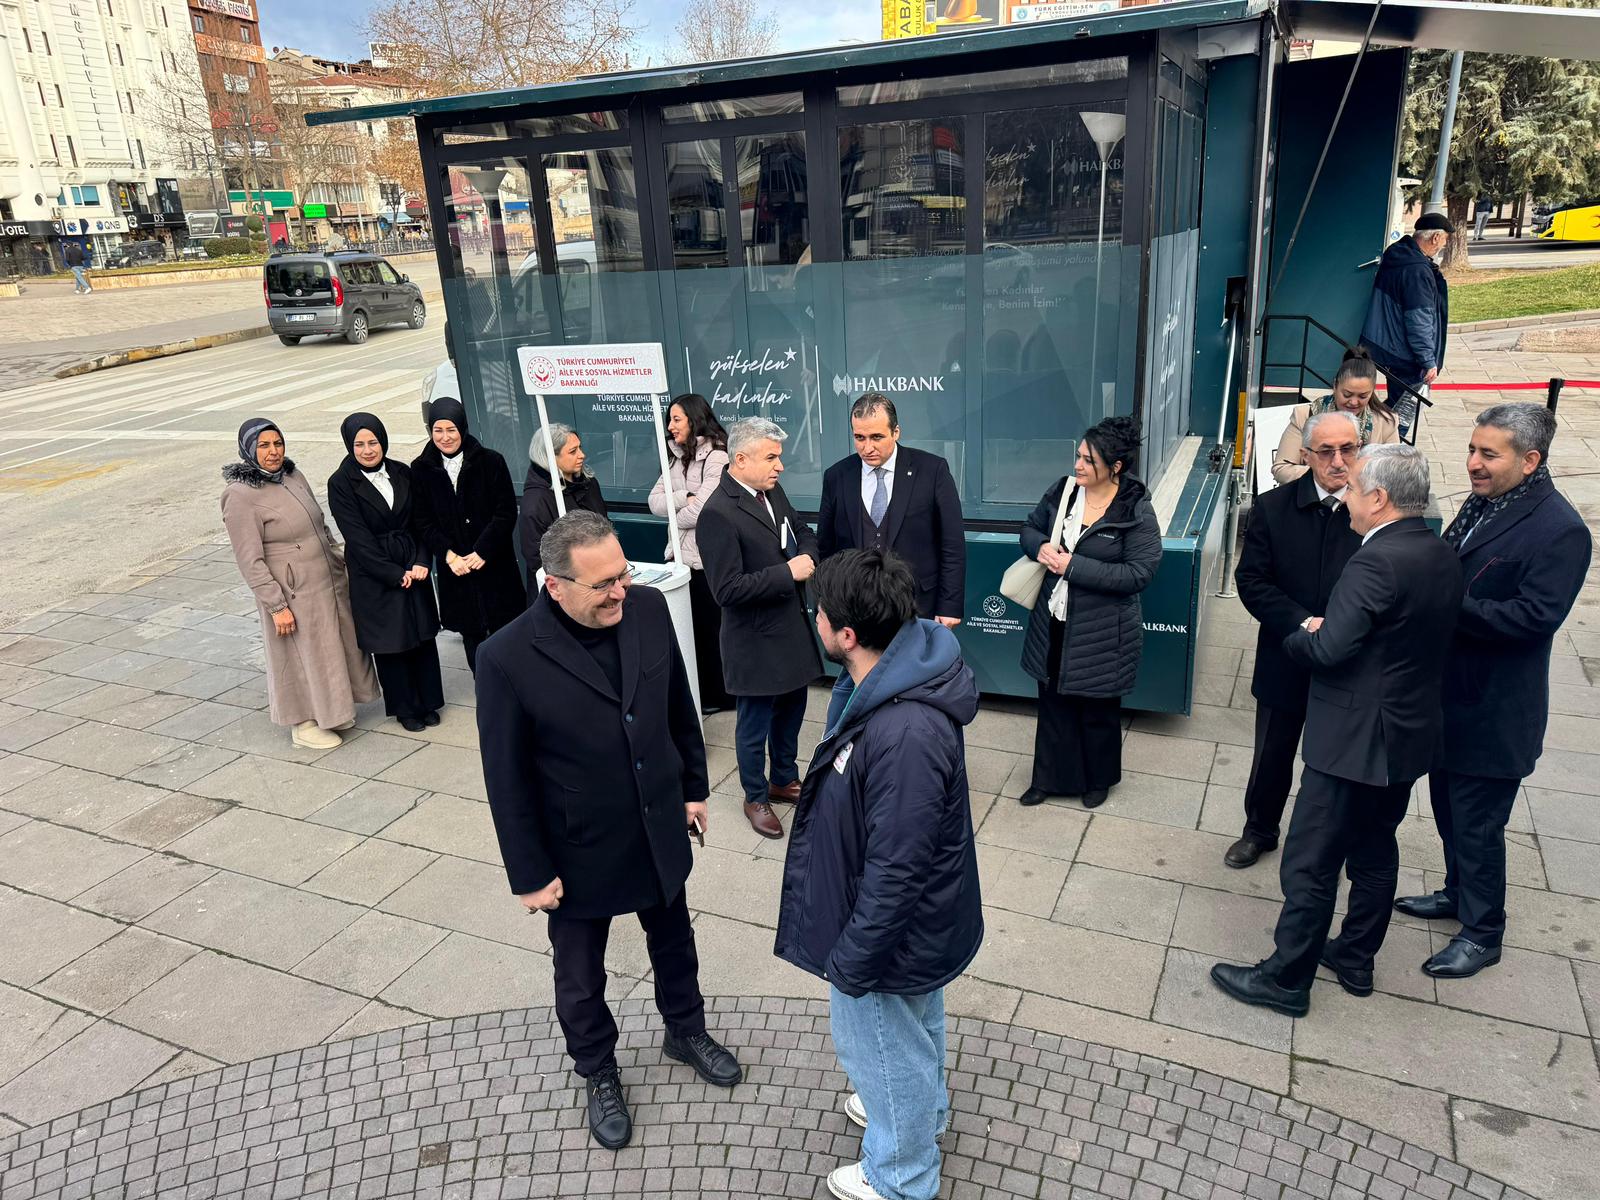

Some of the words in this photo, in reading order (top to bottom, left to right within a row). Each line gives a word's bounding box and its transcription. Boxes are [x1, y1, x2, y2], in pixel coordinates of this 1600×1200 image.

[104, 221, 121, 230] QNB
[6, 225, 29, 236] OTEL
[557, 358, 586, 366] TÜRKİYE
[586, 356, 635, 365] CUMHURİYETİ
[710, 349, 790, 380] yükselen
[585, 368, 612, 376] SOSYAL
[612, 367, 653, 376] HİZMETLER
[560, 379, 598, 387] BAKANLIĞI
[854, 376, 944, 392] HALKBANK
[597, 394, 625, 402] TÜRKİYE
[711, 382, 791, 409] kadınlar
[616, 404, 641, 412] SOSYAL
[719, 414, 737, 422] Kendi
[1141, 621, 1188, 634] ALKBANK
